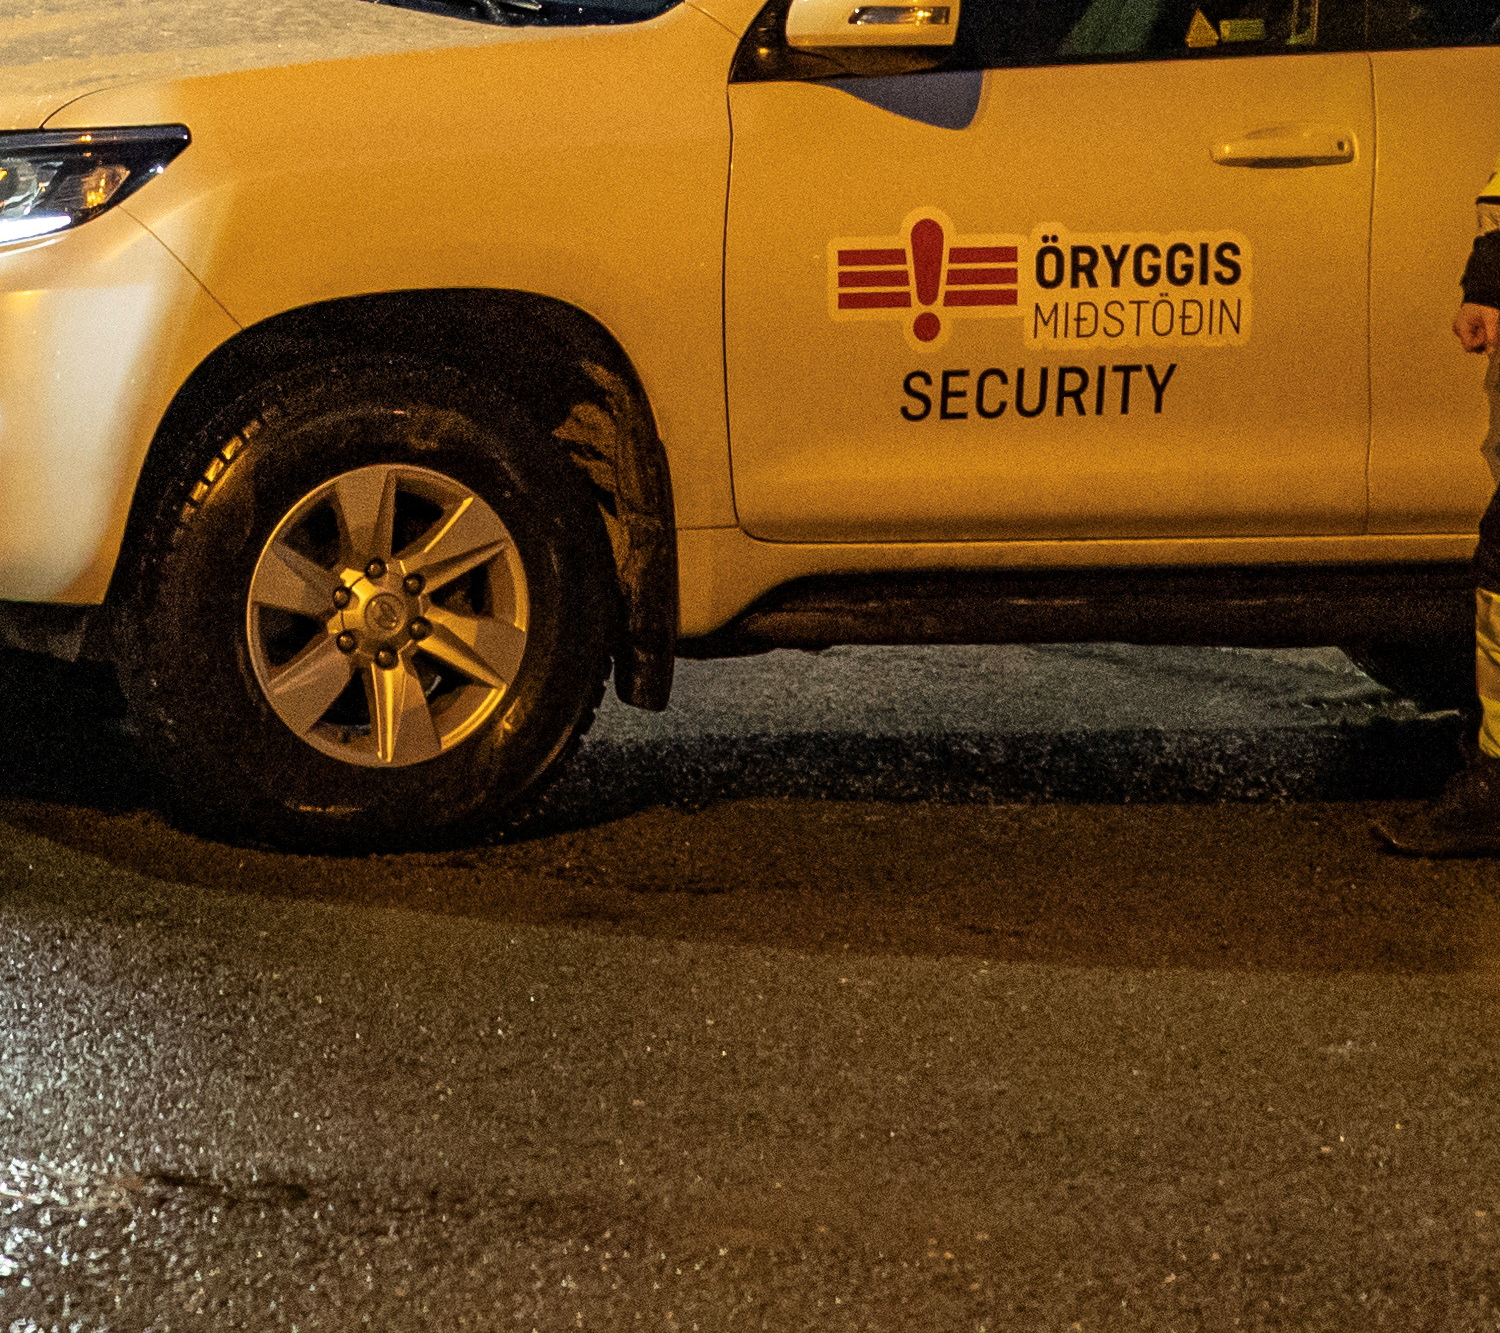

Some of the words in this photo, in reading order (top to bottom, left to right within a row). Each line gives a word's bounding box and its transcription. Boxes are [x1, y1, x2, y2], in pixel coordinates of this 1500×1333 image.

[1034, 234, 1243, 290] ÖRYGGIS
[1032, 293, 1242, 339] MIÐSTÖÐIN
[899, 362, 1178, 423] SECURITY
